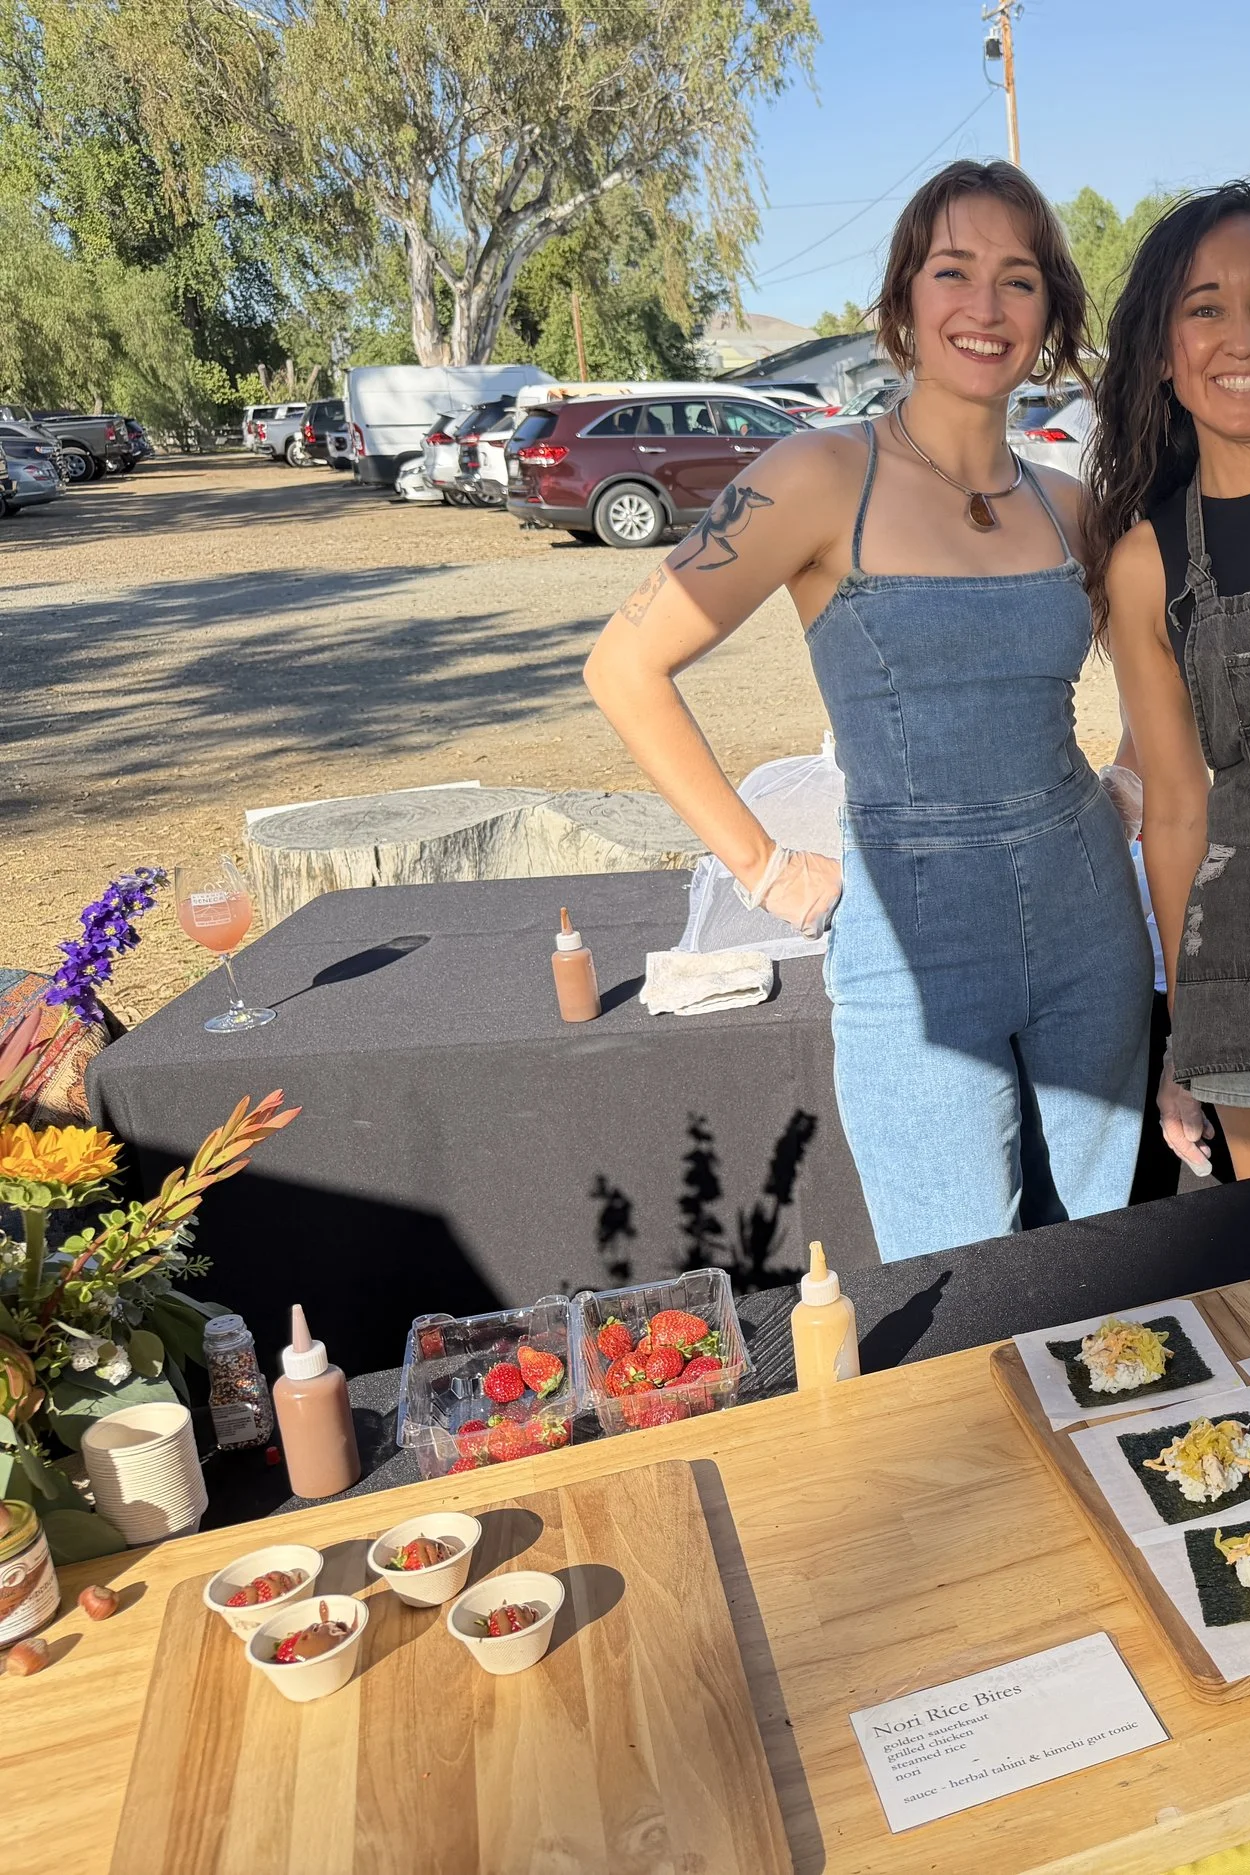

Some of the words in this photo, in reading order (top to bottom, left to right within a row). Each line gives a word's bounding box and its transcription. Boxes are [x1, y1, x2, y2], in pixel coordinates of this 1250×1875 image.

[872, 1714, 922, 1738] Nori
[926, 1704, 970, 1722] Rice
[973, 1685, 1022, 1706] Bites
[883, 1734, 924, 1754] golden
[928, 1713, 989, 1738] sauerkraut
[887, 1744, 925, 1764] grilled
[928, 1730, 974, 1748] chicken
[891, 1750, 941, 1770] steamed
[944, 1742, 967, 1755] rice
[895, 1767, 922, 1782] nori
[903, 1786, 938, 1804] sauce
[949, 1769, 988, 1789] herbal
[992, 1756, 1026, 1776] tahini
[1029, 1754, 1041, 1763] &
[1042, 1738, 1084, 1758] kimchi
[1086, 1732, 1106, 1746] gut
[1108, 1720, 1139, 1736] tonic
